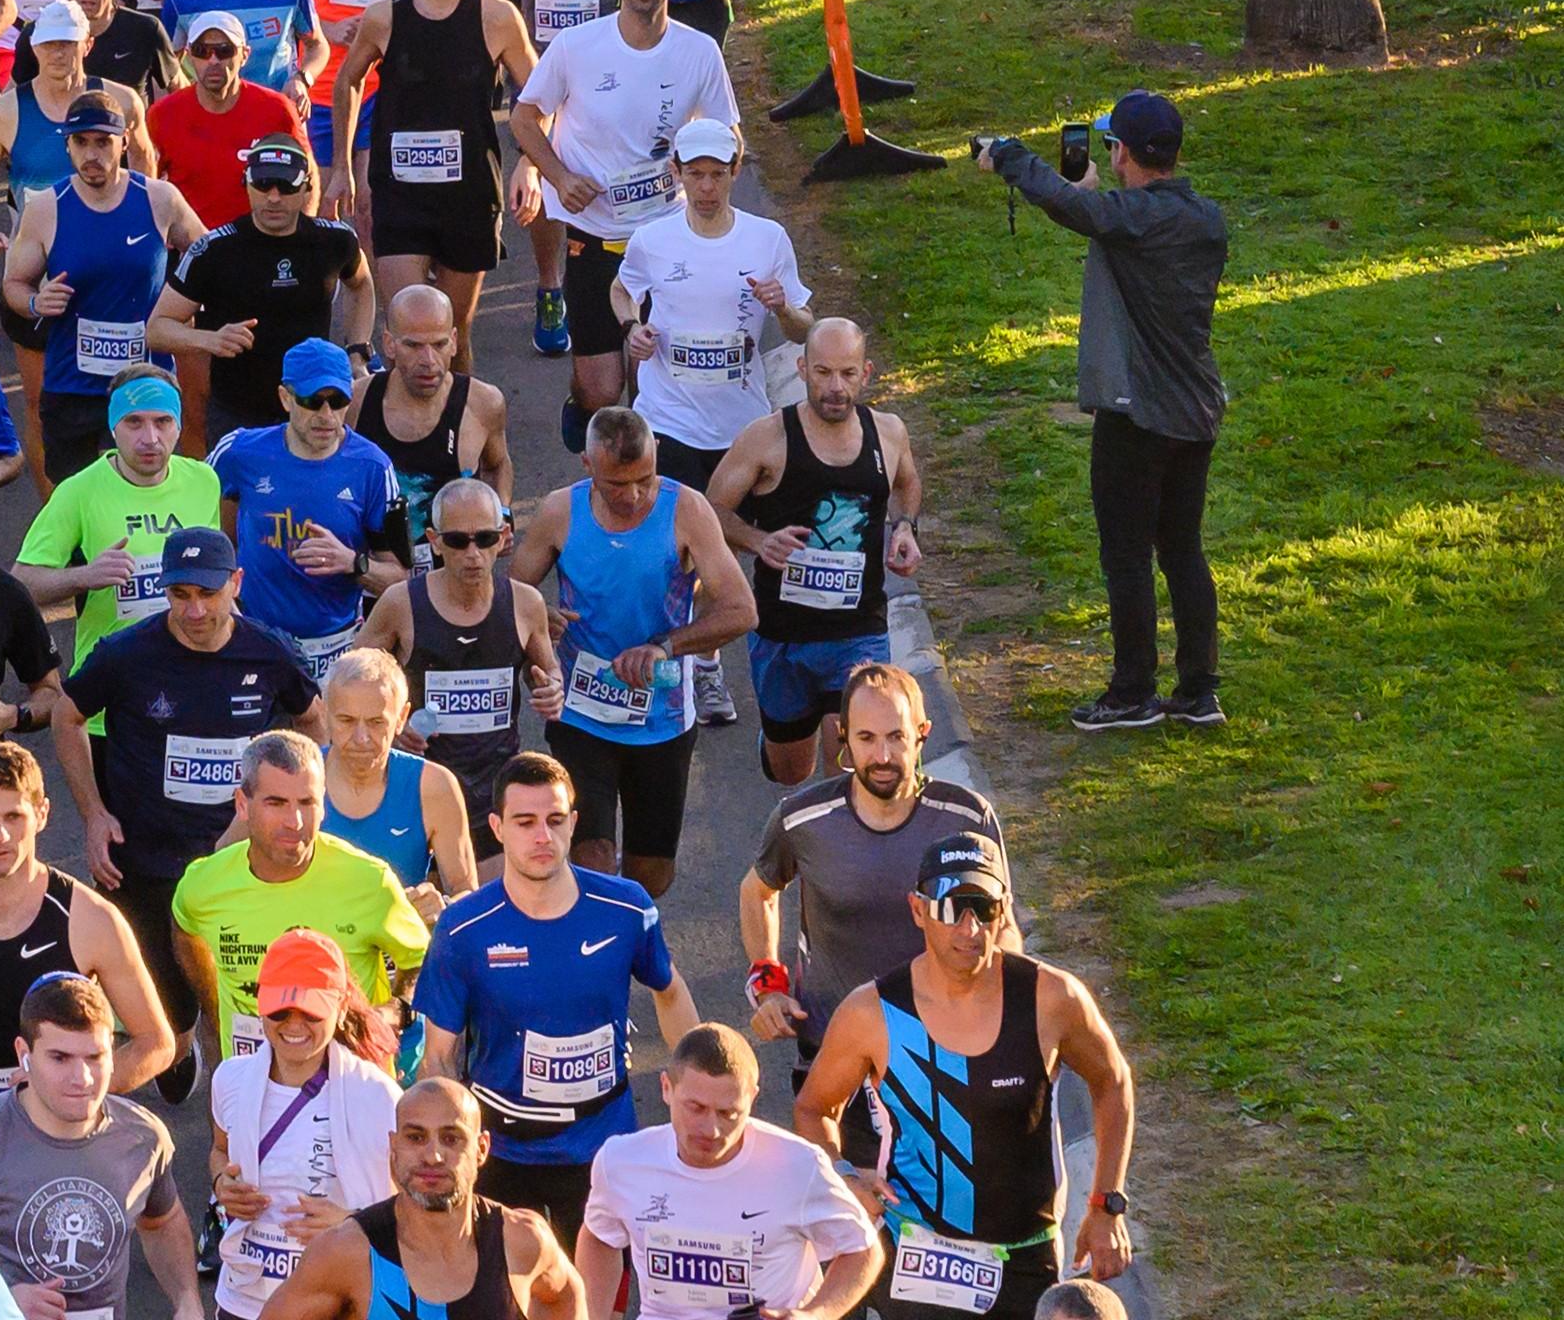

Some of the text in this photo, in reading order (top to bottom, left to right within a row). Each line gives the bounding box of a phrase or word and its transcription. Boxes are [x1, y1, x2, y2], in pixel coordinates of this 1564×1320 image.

[552, 13, 581, 28] 1951
[411, 149, 443, 164] 2954
[629, 181, 660, 199] 2793
[94, 340, 128, 357] 2033
[688, 352, 722, 368] 3339
[125, 513, 184, 536] FILA
[806, 569, 843, 589] 1099
[592, 680, 629, 704] 2934
[450, 692, 490, 711] 2936
[190, 763, 232, 781] 2486
[219, 933, 240, 944] NIKE
[219, 944, 267, 955] NIGHTRUN
[220, 955, 258, 966] TEL AVIV
[552, 1059, 594, 1081] 1089
[677, 1239, 721, 1251] SAMSUNG
[674, 1257, 721, 1282] 1110
[925, 1254, 973, 1283] 3166
